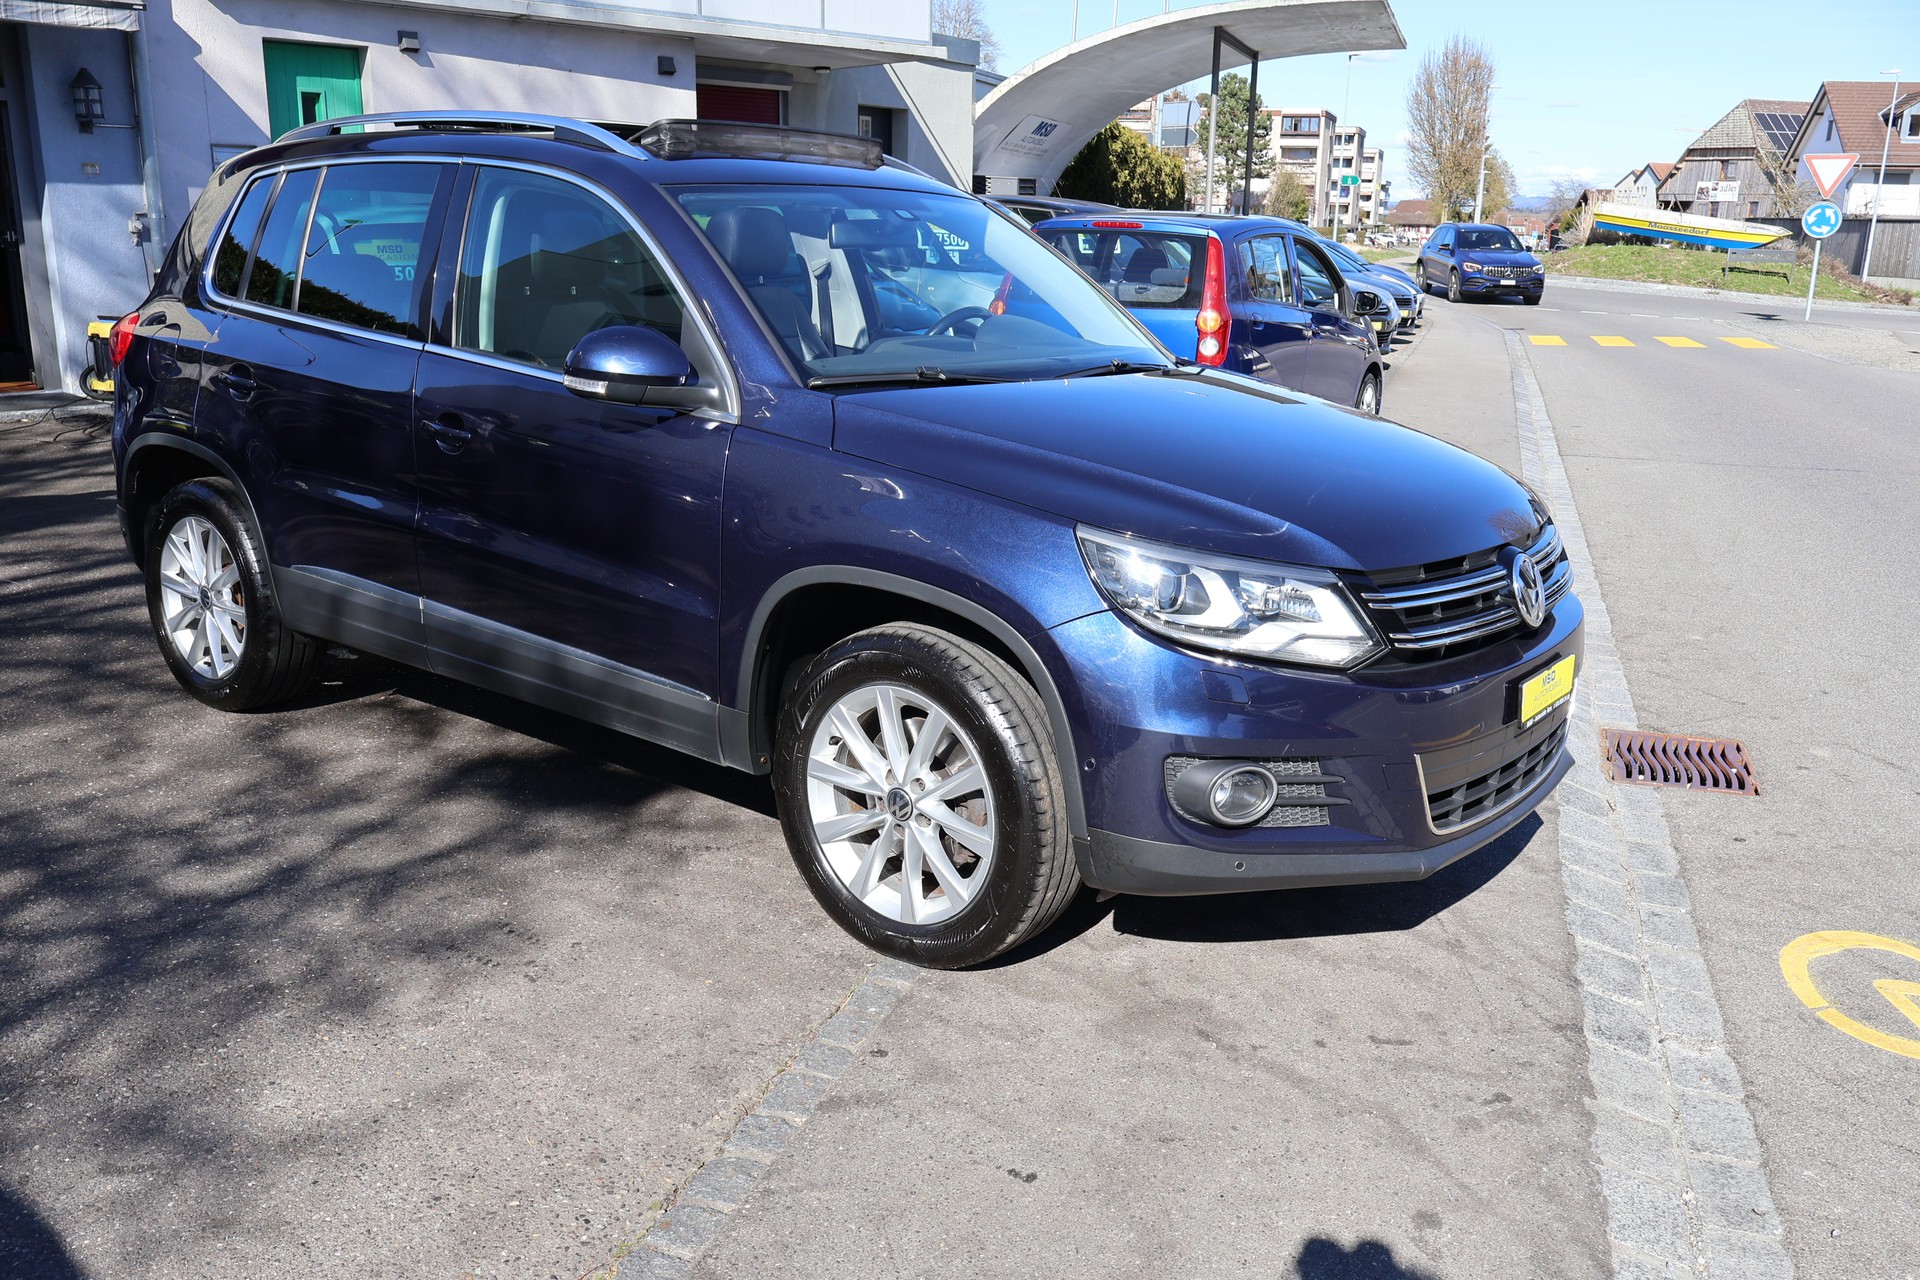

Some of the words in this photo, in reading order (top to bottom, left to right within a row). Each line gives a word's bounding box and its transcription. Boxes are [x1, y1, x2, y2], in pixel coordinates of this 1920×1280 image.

[1031, 121, 1058, 137] MSD
[1647, 222, 1711, 236] Moosseedorf
[376, 245, 403, 254] MSD
[1541, 669, 1557, 688] MSD
